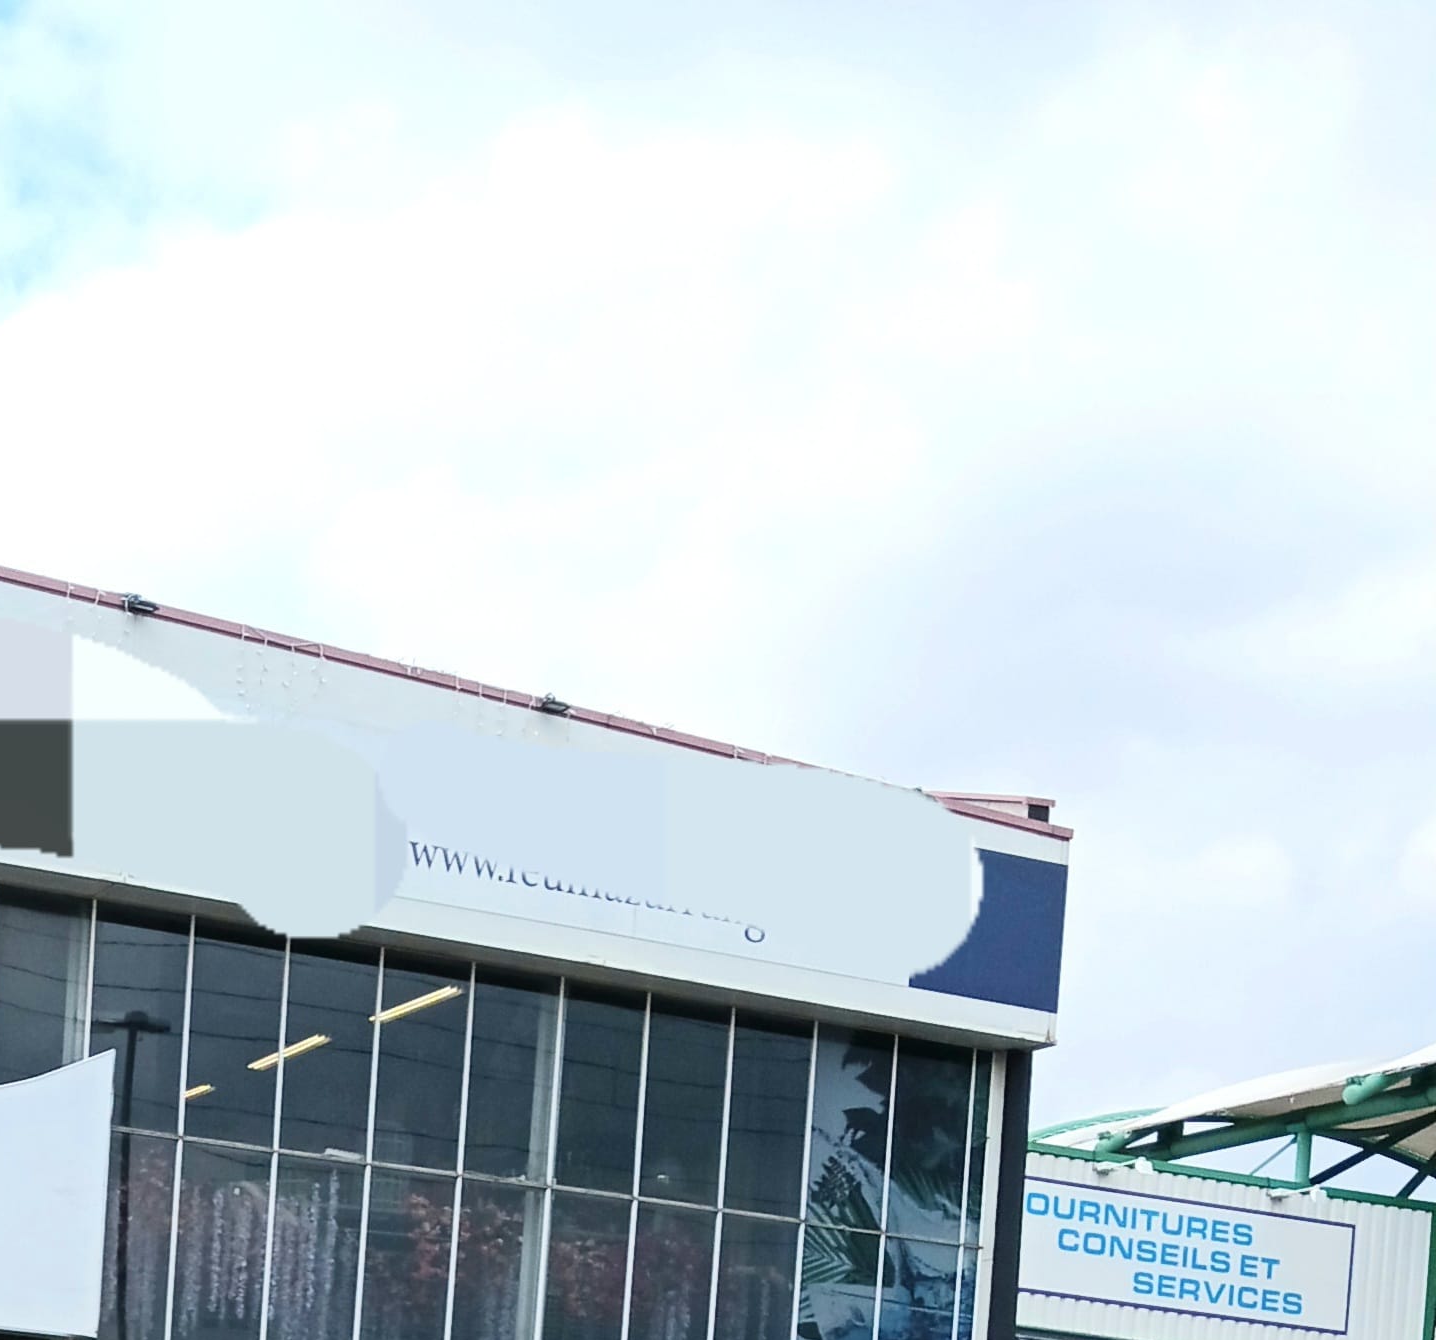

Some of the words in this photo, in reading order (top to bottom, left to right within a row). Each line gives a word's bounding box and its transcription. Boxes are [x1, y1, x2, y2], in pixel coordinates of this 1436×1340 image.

[1025, 1192, 1254, 1246] OURNITURES
[1057, 1228, 1230, 1274] CONSEILS
[1240, 1255, 1281, 1280] ET
[1132, 1271, 1303, 1316] SERVICES
